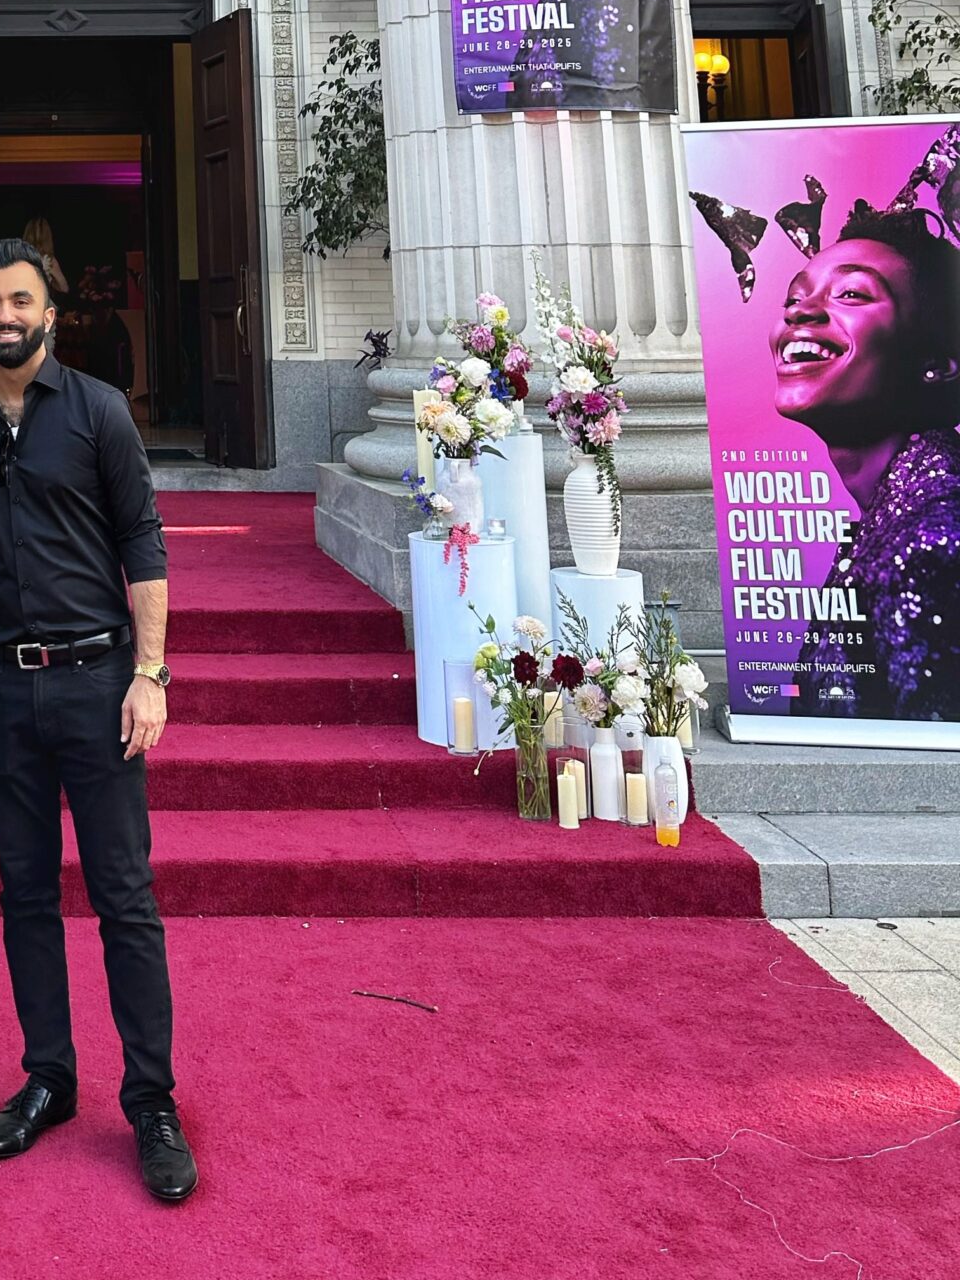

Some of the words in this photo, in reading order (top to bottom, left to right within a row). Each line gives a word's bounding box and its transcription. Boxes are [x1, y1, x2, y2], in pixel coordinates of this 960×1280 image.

[461, 2, 575, 35] FESTIVAL
[462, 41, 490, 53] JUNE
[496, 38, 533, 50] 26-29
[541, 37, 572, 49] 2025
[464, 63, 526, 75] ENTERTAINMENT
[528, 62, 548, 71] THAT
[550, 62, 582, 71] UPLIFTS
[474, 83, 497, 92] WCFF
[722, 450, 746, 462] 2ND
[754, 450, 809, 462] EDITION
[724, 471, 830, 504] WORLD
[727, 509, 853, 543] CULTURE
[730, 548, 802, 581] FILM
[733, 587, 867, 621] FESTIVAL
[736, 631, 769, 643] JUNE
[777, 631, 819, 644] 26-29
[829, 632, 863, 644] 2025
[738, 661, 812, 672] ENTERTAINMENT
[814, 662, 837, 672] THAT
[839, 663, 876, 674] UPLIFTS
[752, 685, 779, 695] WCFF
